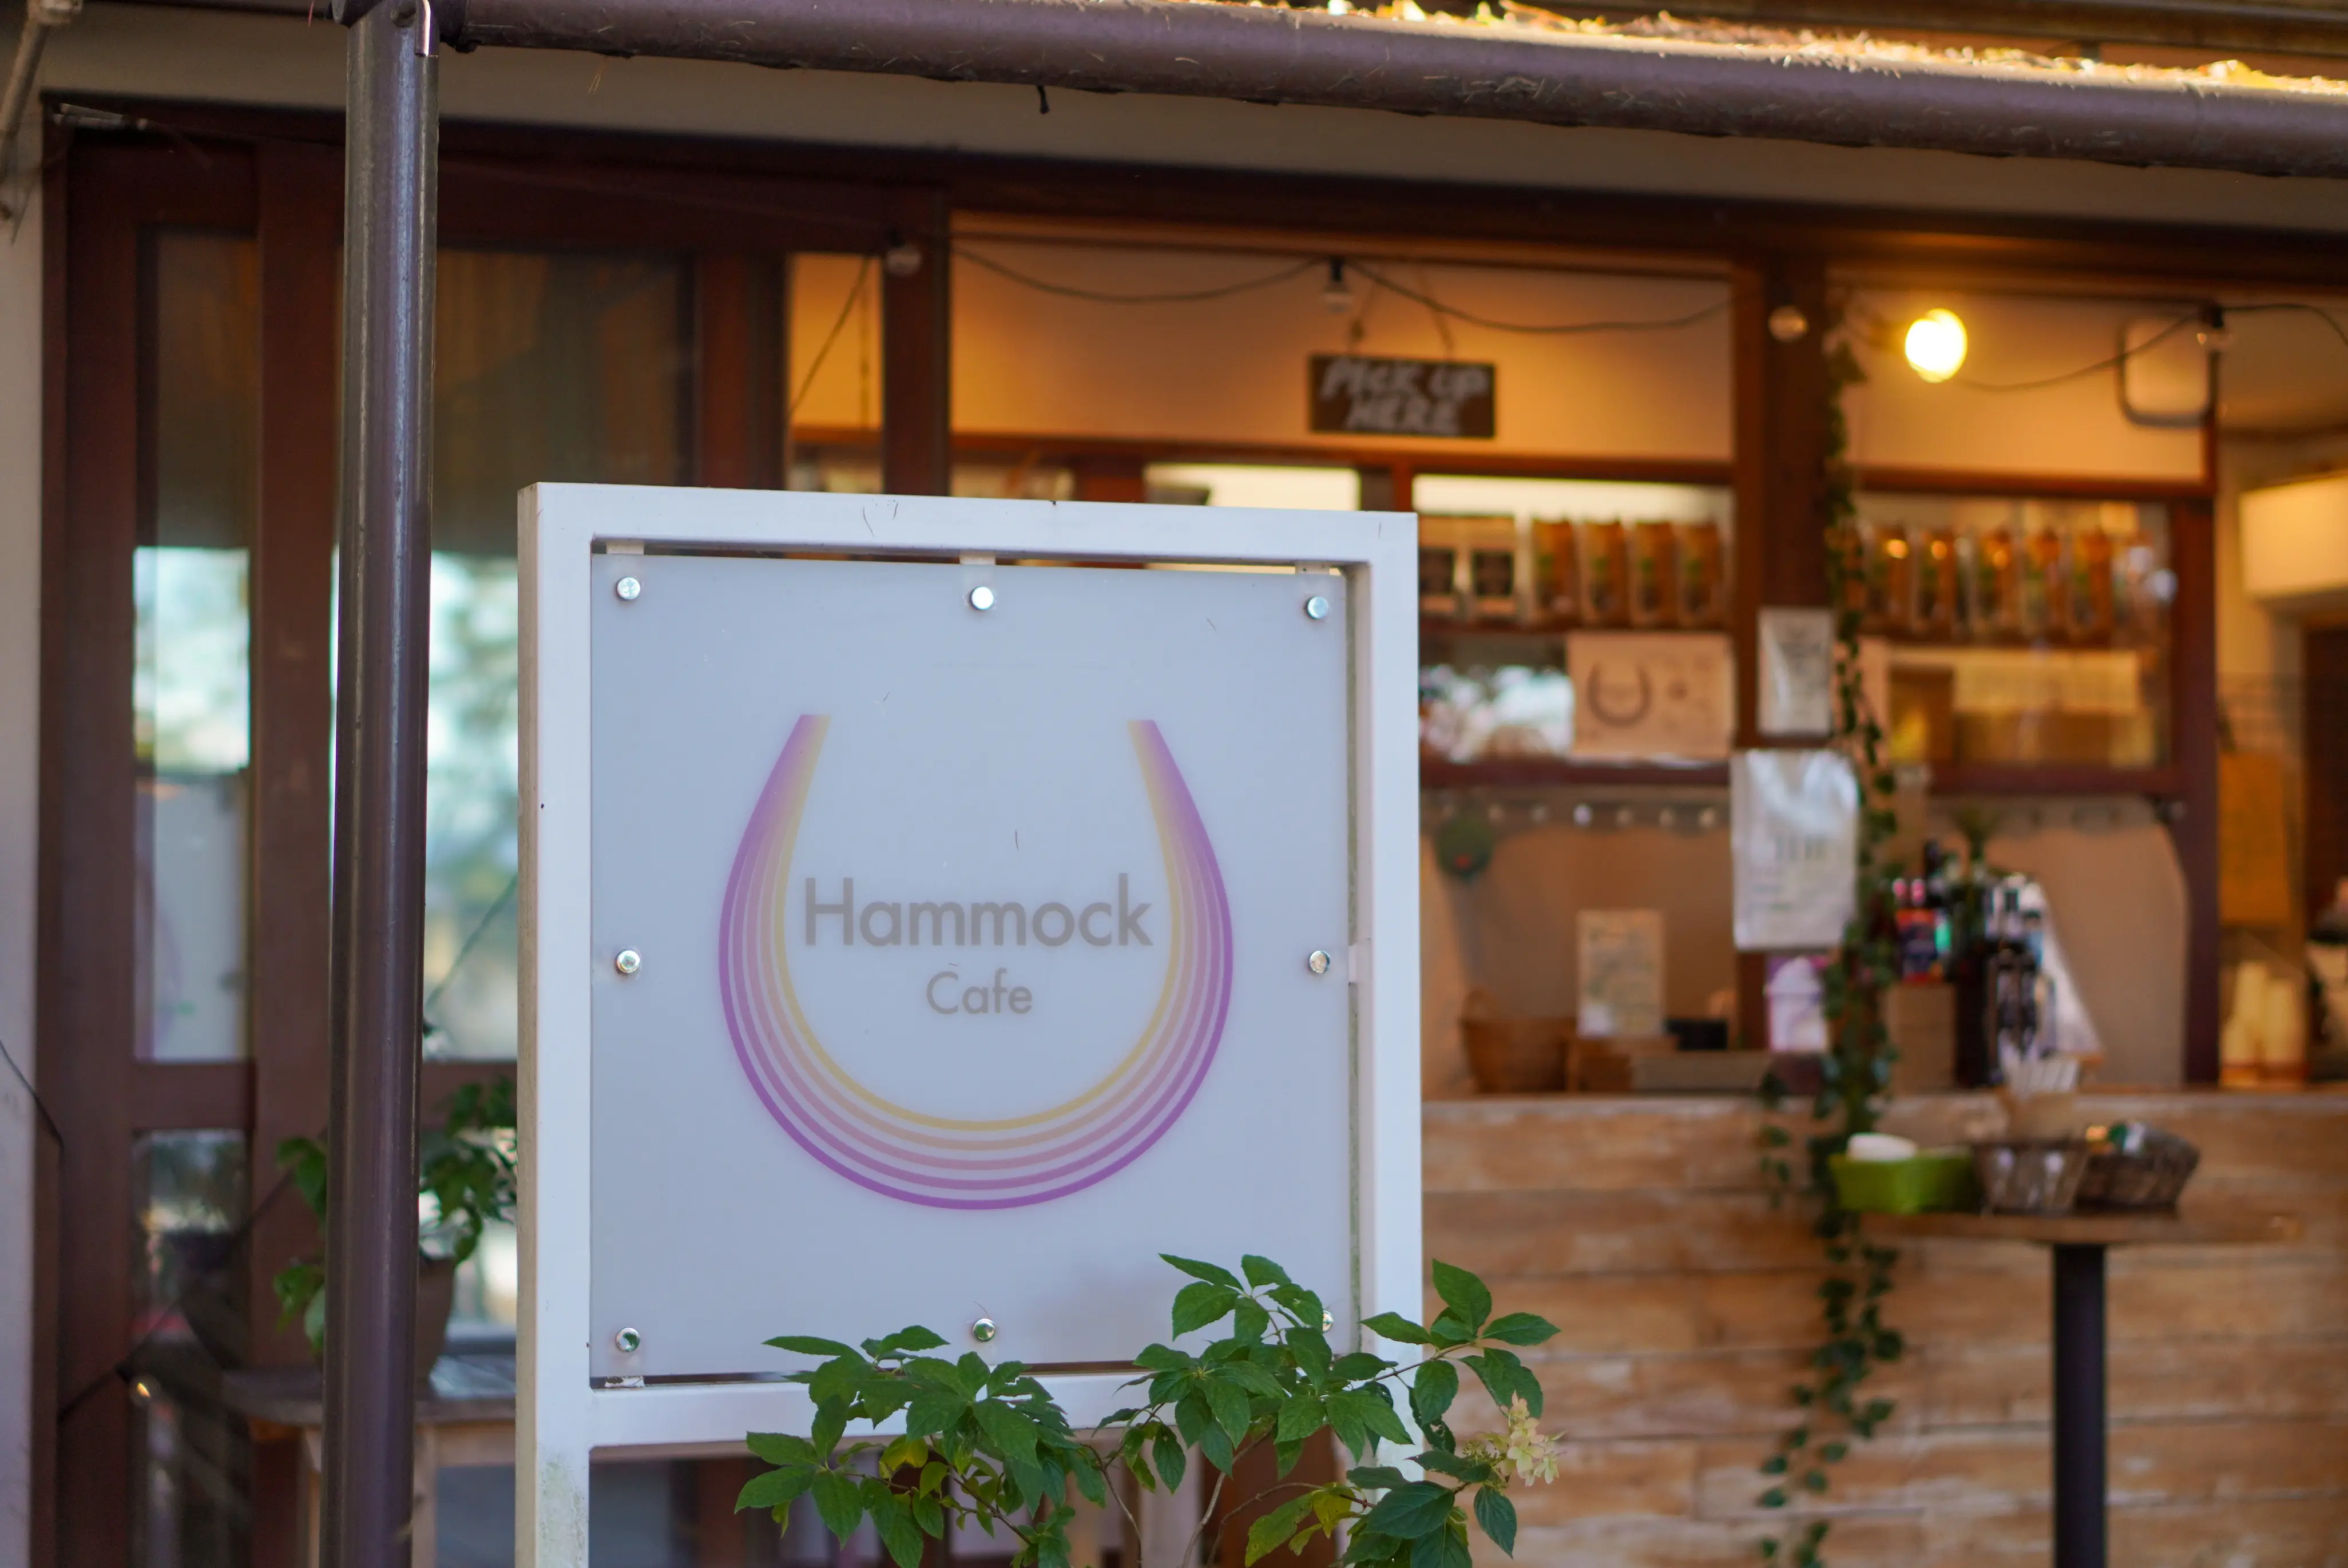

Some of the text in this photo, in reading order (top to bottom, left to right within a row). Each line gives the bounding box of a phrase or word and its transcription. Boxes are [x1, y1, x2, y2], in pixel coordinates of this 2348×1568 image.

[1429, 366, 1489, 404] UP
[1344, 396, 1460, 436] HERE
[804, 872, 1153, 947] Hammock
[926, 968, 1033, 1015] Cafe
